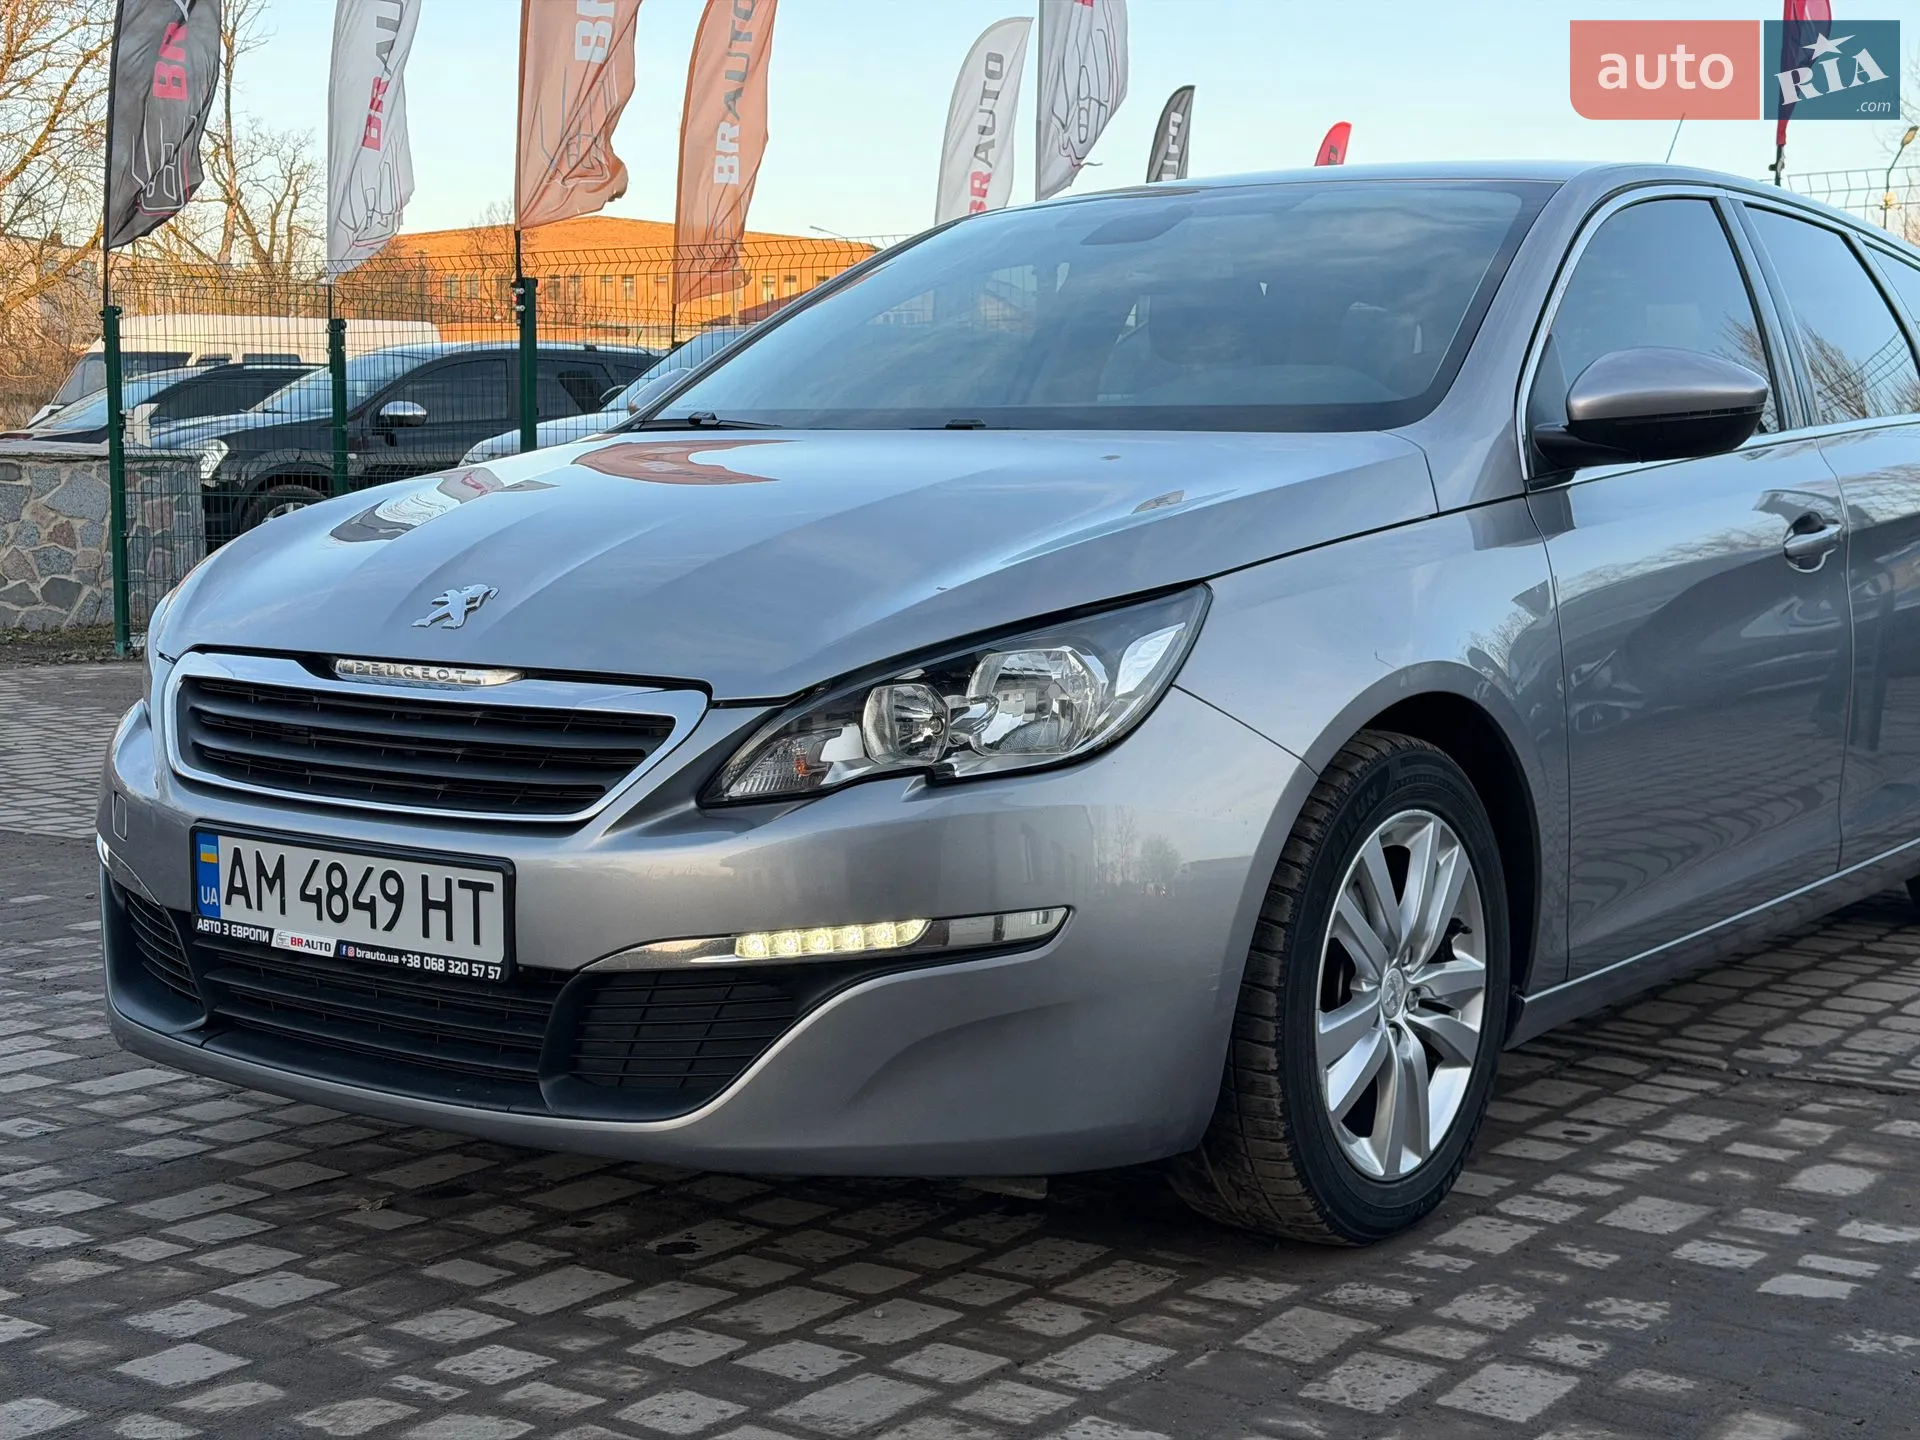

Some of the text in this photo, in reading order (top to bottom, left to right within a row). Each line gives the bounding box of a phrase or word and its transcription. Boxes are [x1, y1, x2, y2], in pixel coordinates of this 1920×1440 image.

[352, 661, 468, 684] PEUGEOT
[200, 885, 220, 907] UA
[224, 846, 495, 946] AM 4849 HT
[196, 918, 221, 937] АВТО
[230, 924, 270, 944] ЄВРОПИ
[290, 936, 332, 953] BRAUTO
[355, 947, 502, 981] brauto.ua +38 068 320 57 57
